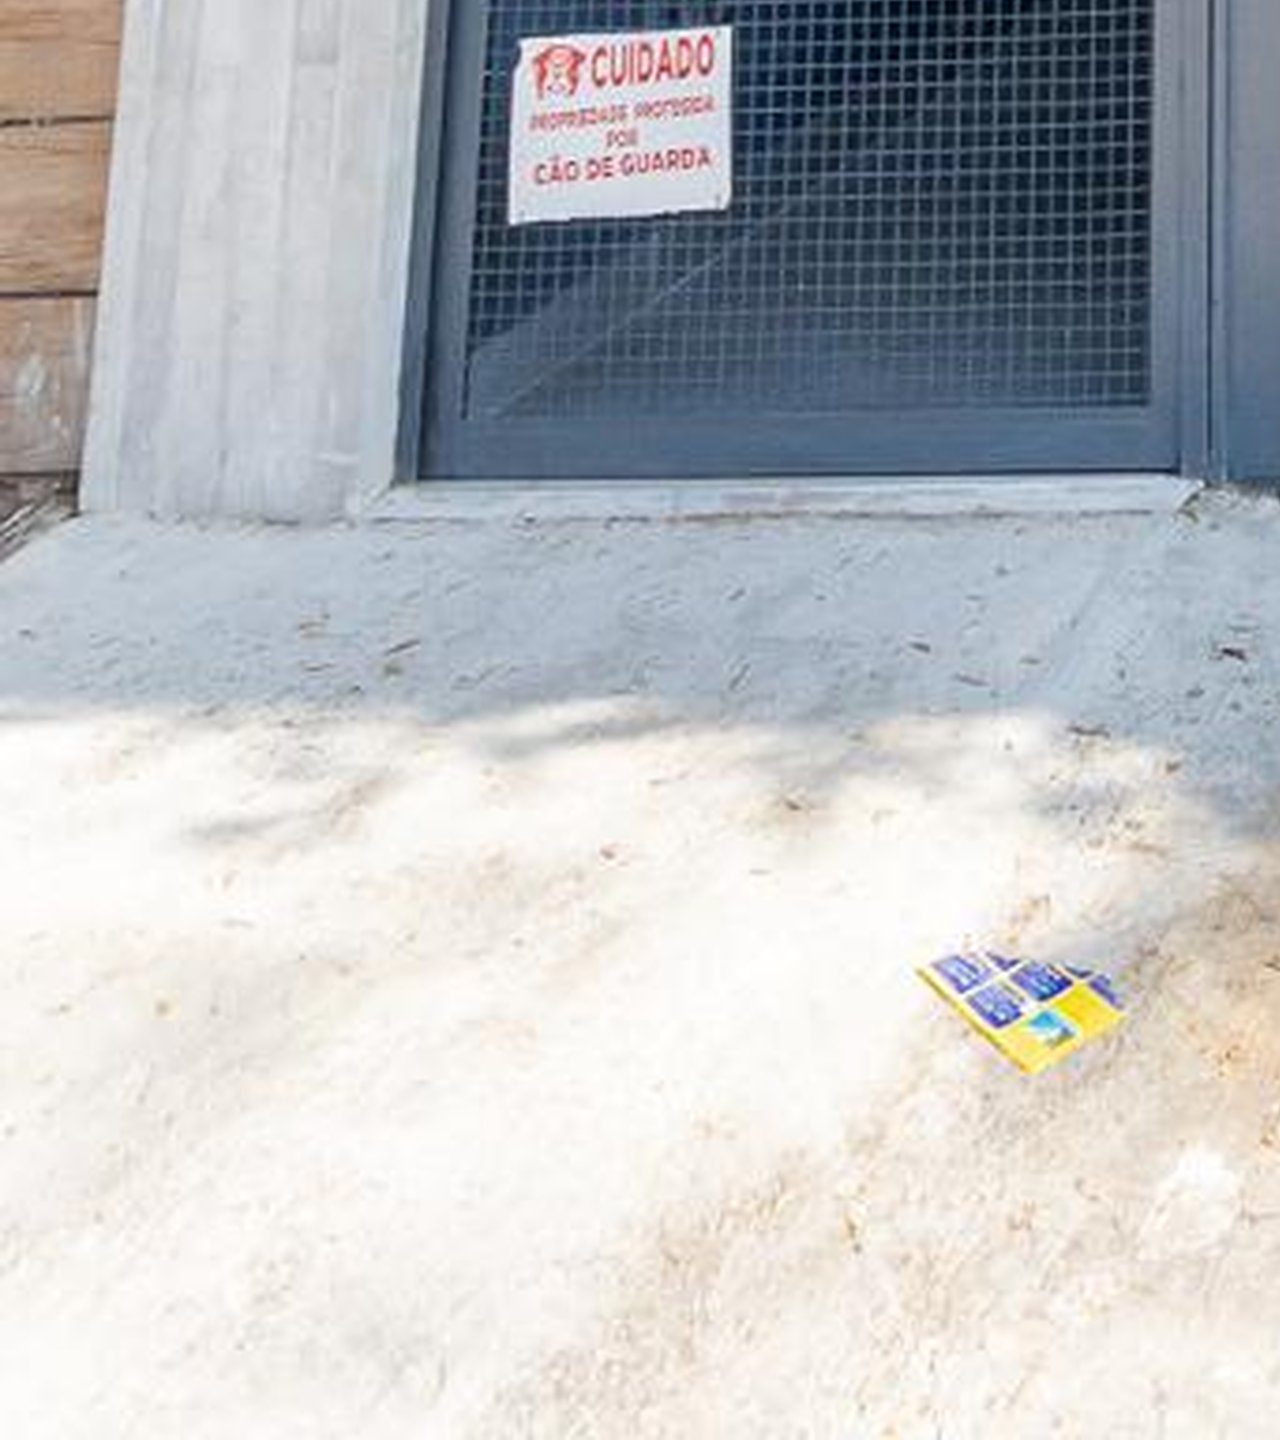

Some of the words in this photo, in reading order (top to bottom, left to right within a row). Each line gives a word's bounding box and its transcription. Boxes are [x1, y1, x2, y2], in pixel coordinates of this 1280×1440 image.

[590, 33, 715, 88] CUIDADO
[533, 154, 580, 185] CÃO
[586, 156, 614, 180] DE
[619, 144, 711, 177] GUARDA
